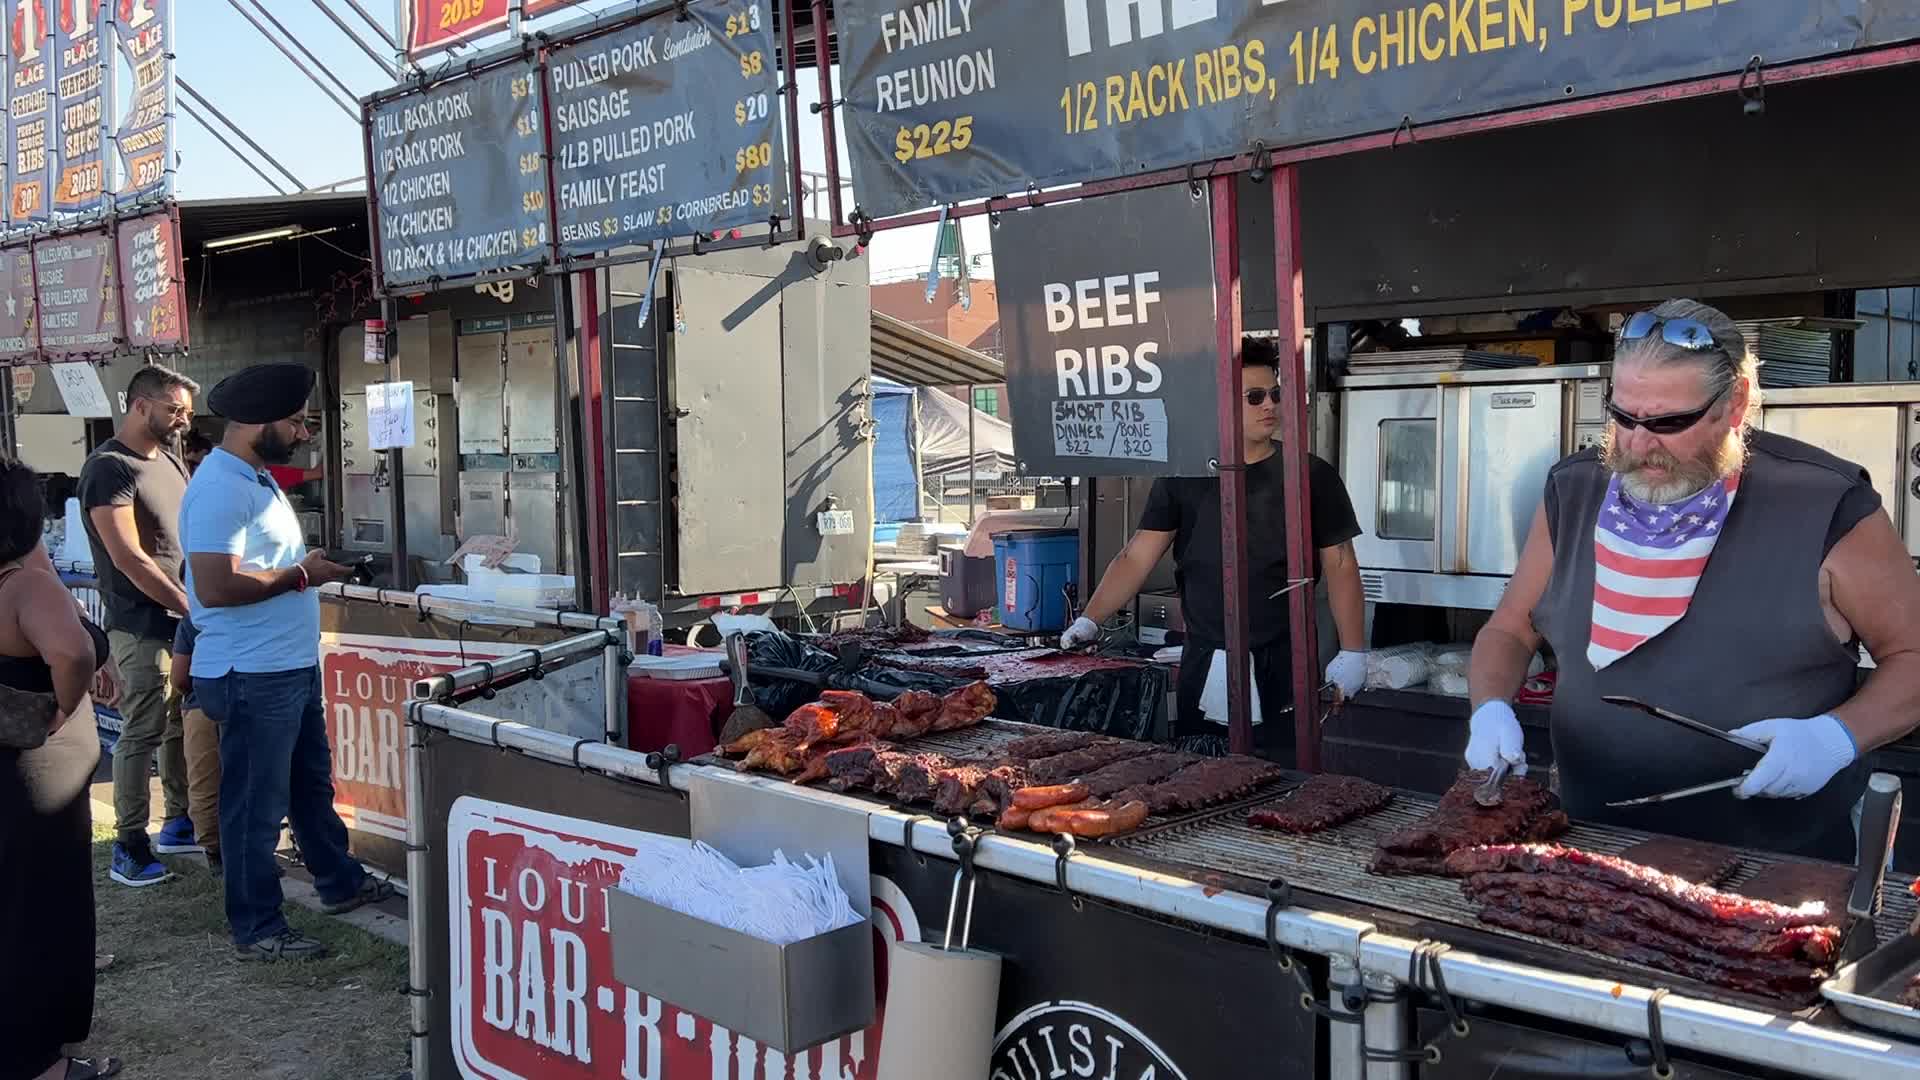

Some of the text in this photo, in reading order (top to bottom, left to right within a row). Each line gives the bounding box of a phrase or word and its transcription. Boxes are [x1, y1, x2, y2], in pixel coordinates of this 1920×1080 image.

[440, 0, 485, 29] 2019
[881, 0, 972, 53] FAMILY
[64, 37, 99, 68] PLACE
[127, 24, 162, 58] PLACE
[553, 4, 760, 93] PULLED PORK Sandwich $13
[15, 64, 45, 88] PLACE
[876, 48, 996, 113] REUNION
[1060, 81, 1098, 134] 1/2
[1105, 58, 1189, 126] RACK
[1194, 40, 1277, 102] RIBS,
[1289, 23, 1339, 85] 1/4
[1351, 0, 1548, 76] CHICKEN,
[557, 51, 762, 132] SAUSAGE $8
[377, 112, 404, 140] FULL
[404, 101, 438, 132] RACK
[437, 92, 472, 123] PORK
[560, 93, 768, 170] 1LB PULLED PORK $20
[17, 147, 44, 174] RIBS
[394, 139, 429, 169] RACK
[431, 132, 465, 162] PORK
[895, 116, 973, 164] $225
[71, 167, 98, 196] 2019
[384, 184, 398, 207] 1/2
[400, 170, 450, 203] CHICKEN
[561, 142, 771, 211] FAMILY FEAST $80
[401, 206, 453, 236] CHICKEN
[562, 184, 771, 242] BEANS $3 SLAW $3 CORNBREAD $3
[404, 244, 434, 270] RACK
[437, 241, 445, 265] &
[466, 229, 518, 261] CHICKEN
[1044, 271, 1160, 332] BEEF
[1055, 342, 1162, 397] RIBS
[1056, 401, 1145, 422] SHORT RIB
[1120, 422, 1151, 437] BONE
[1066, 438, 1152, 456] $22 $20
